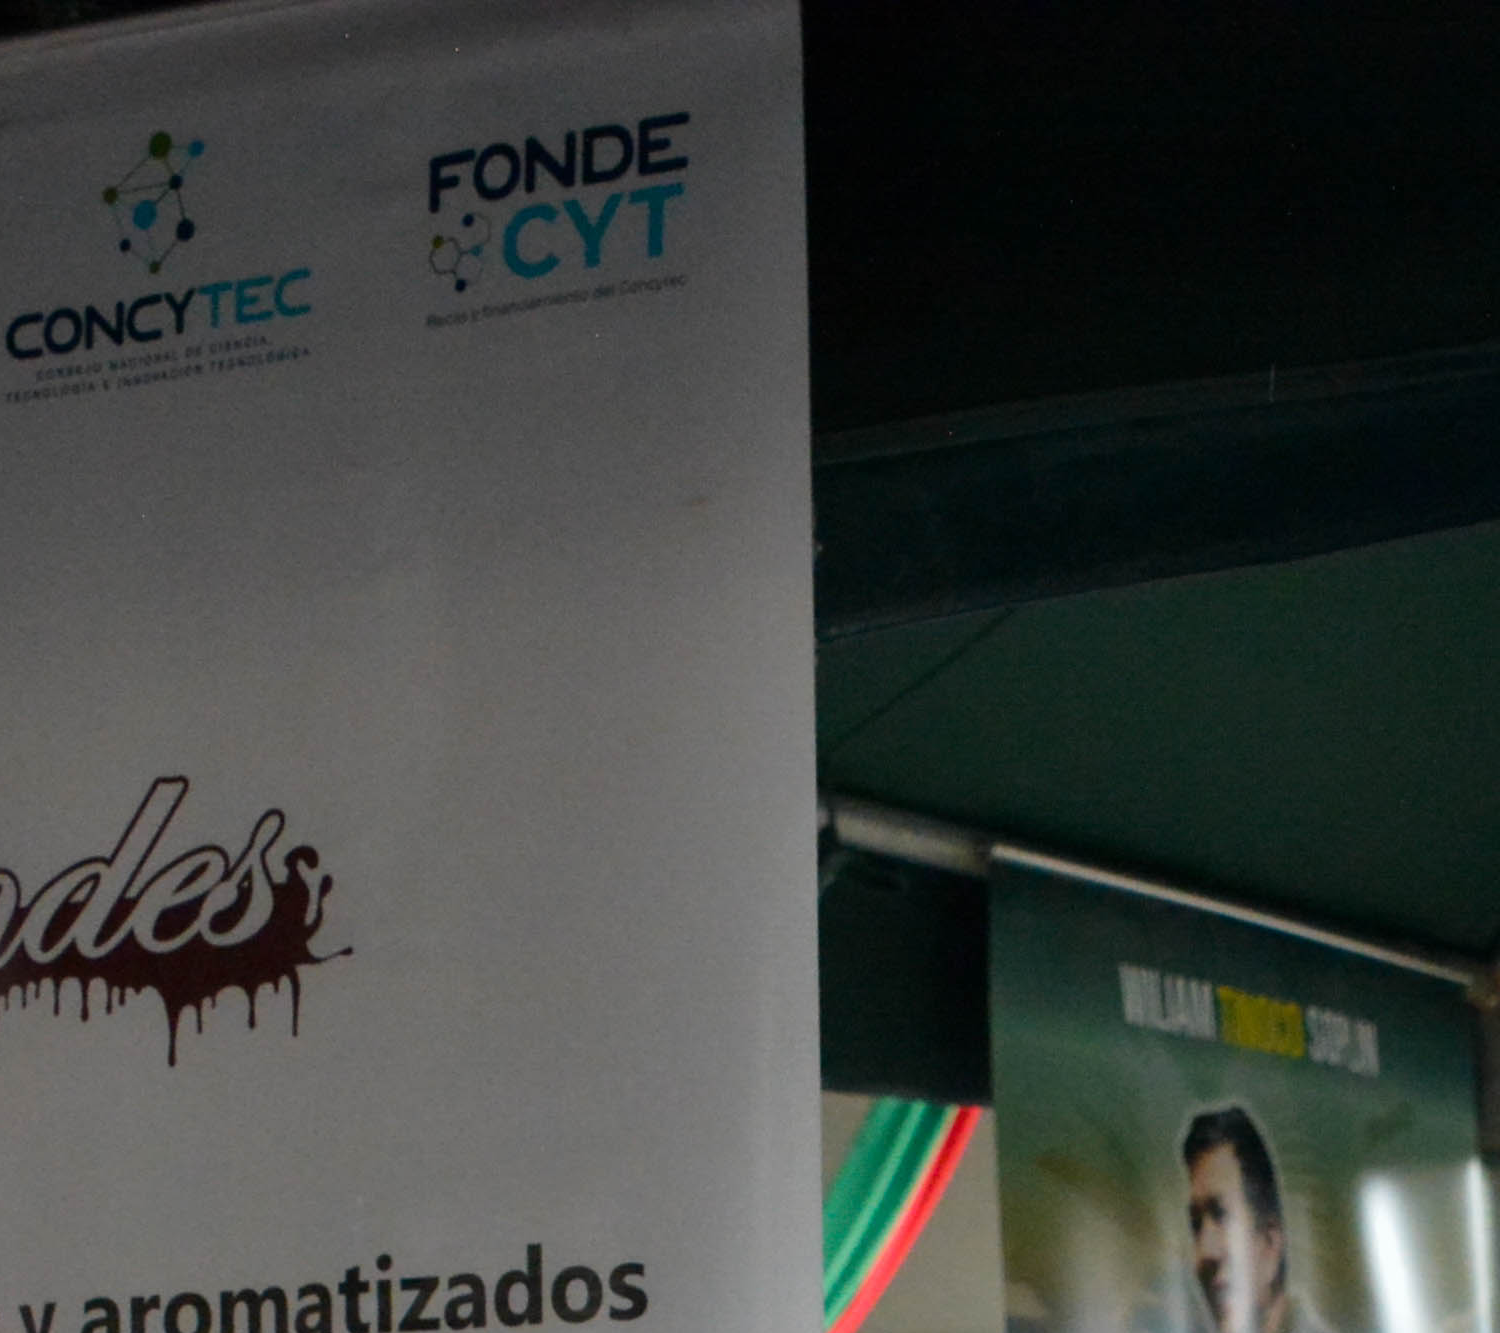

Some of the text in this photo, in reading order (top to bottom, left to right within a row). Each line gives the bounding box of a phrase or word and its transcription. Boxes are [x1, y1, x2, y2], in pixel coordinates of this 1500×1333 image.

[428, 112, 690, 213] FONDE
[503, 182, 685, 279] CYT
[5, 266, 311, 360] CONCYTEC
